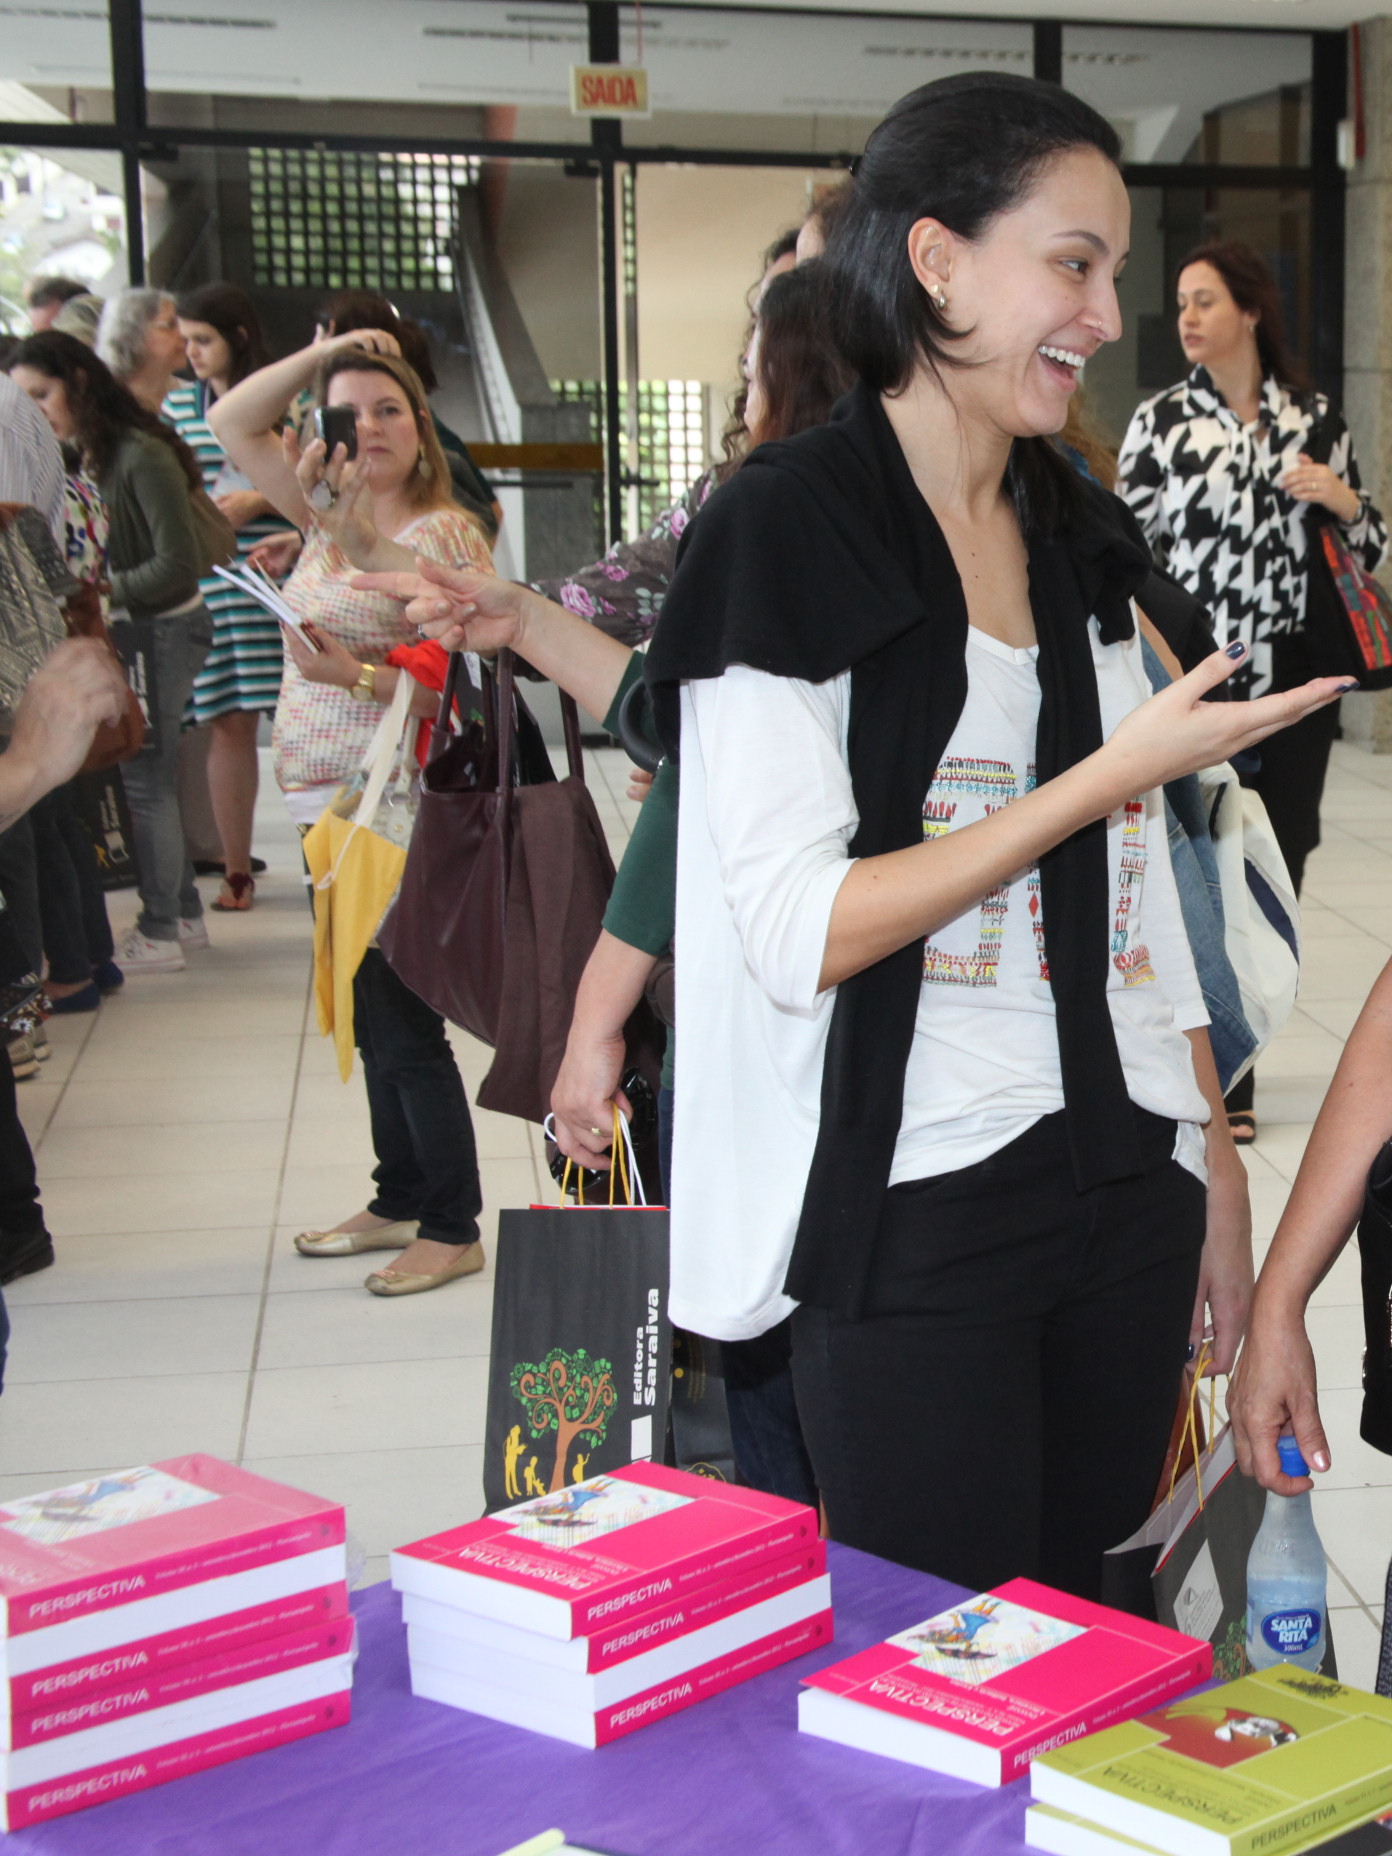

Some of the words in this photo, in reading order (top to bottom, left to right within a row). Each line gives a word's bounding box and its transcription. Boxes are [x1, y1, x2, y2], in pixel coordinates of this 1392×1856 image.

[633, 1326, 644, 1405] Editora
[644, 1288, 660, 1406] Saraiva
[458, 1547, 592, 1591] PERSPECTIVA
[28, 1574, 147, 1619] PERSPECTIVA
[586, 1578, 673, 1622] PERSPECTIVA
[602, 1611, 685, 1656] PERSPECTIVA
[1270, 1616, 1313, 1632] SANTA
[1278, 1630, 1309, 1643] RITA
[31, 1650, 149, 1699] PERSPECTIVA
[30, 1687, 150, 1735] PERSPECTIVA
[610, 1682, 693, 1729] PERSPECTIVA
[869, 1680, 1014, 1736] PERSPECTIVA
[1013, 1722, 1087, 1769] PERSPECTIVA
[28, 1762, 148, 1814] PERSPECTIVA
[1251, 1803, 1338, 1851] PERSPECTIVA
